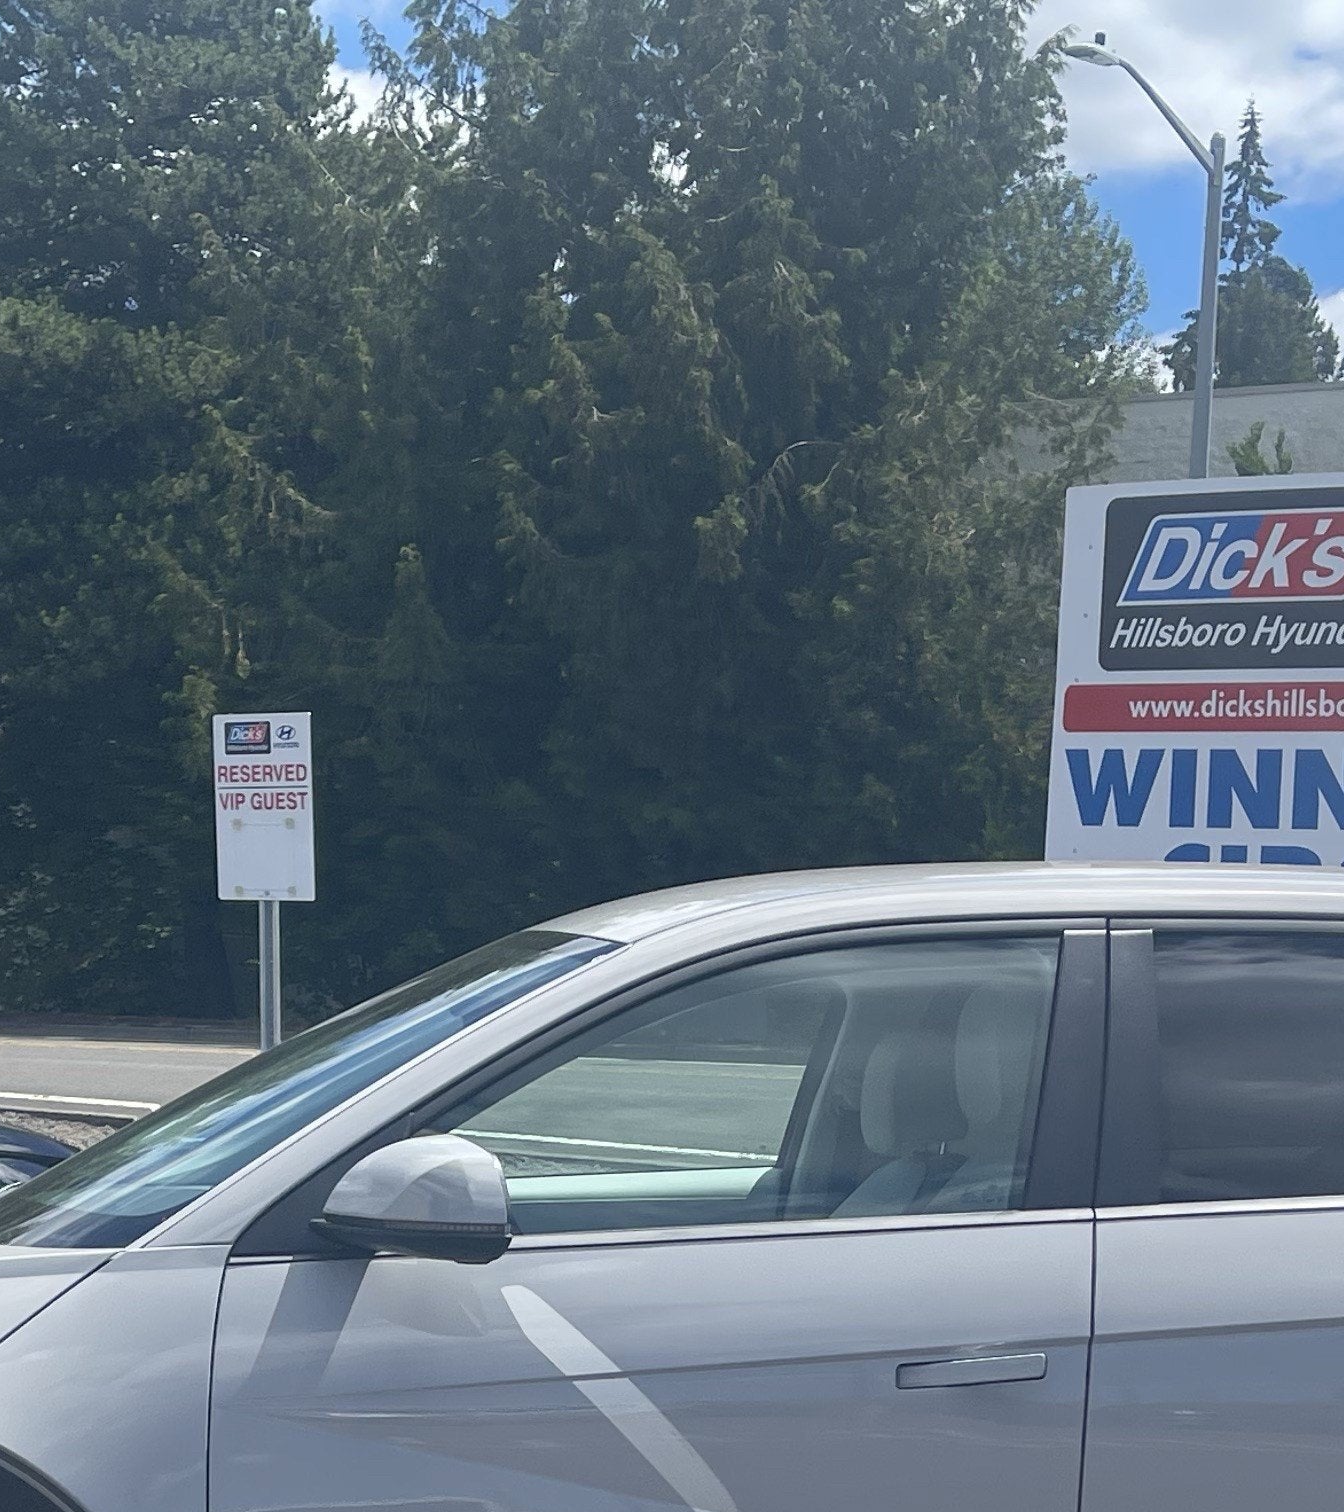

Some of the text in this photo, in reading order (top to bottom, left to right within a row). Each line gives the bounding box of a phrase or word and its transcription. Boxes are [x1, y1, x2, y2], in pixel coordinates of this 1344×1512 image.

[1109, 617, 1246, 649] Hillsboro
[217, 764, 307, 783] RESERVED
[219, 791, 308, 811] VIP GUEST
